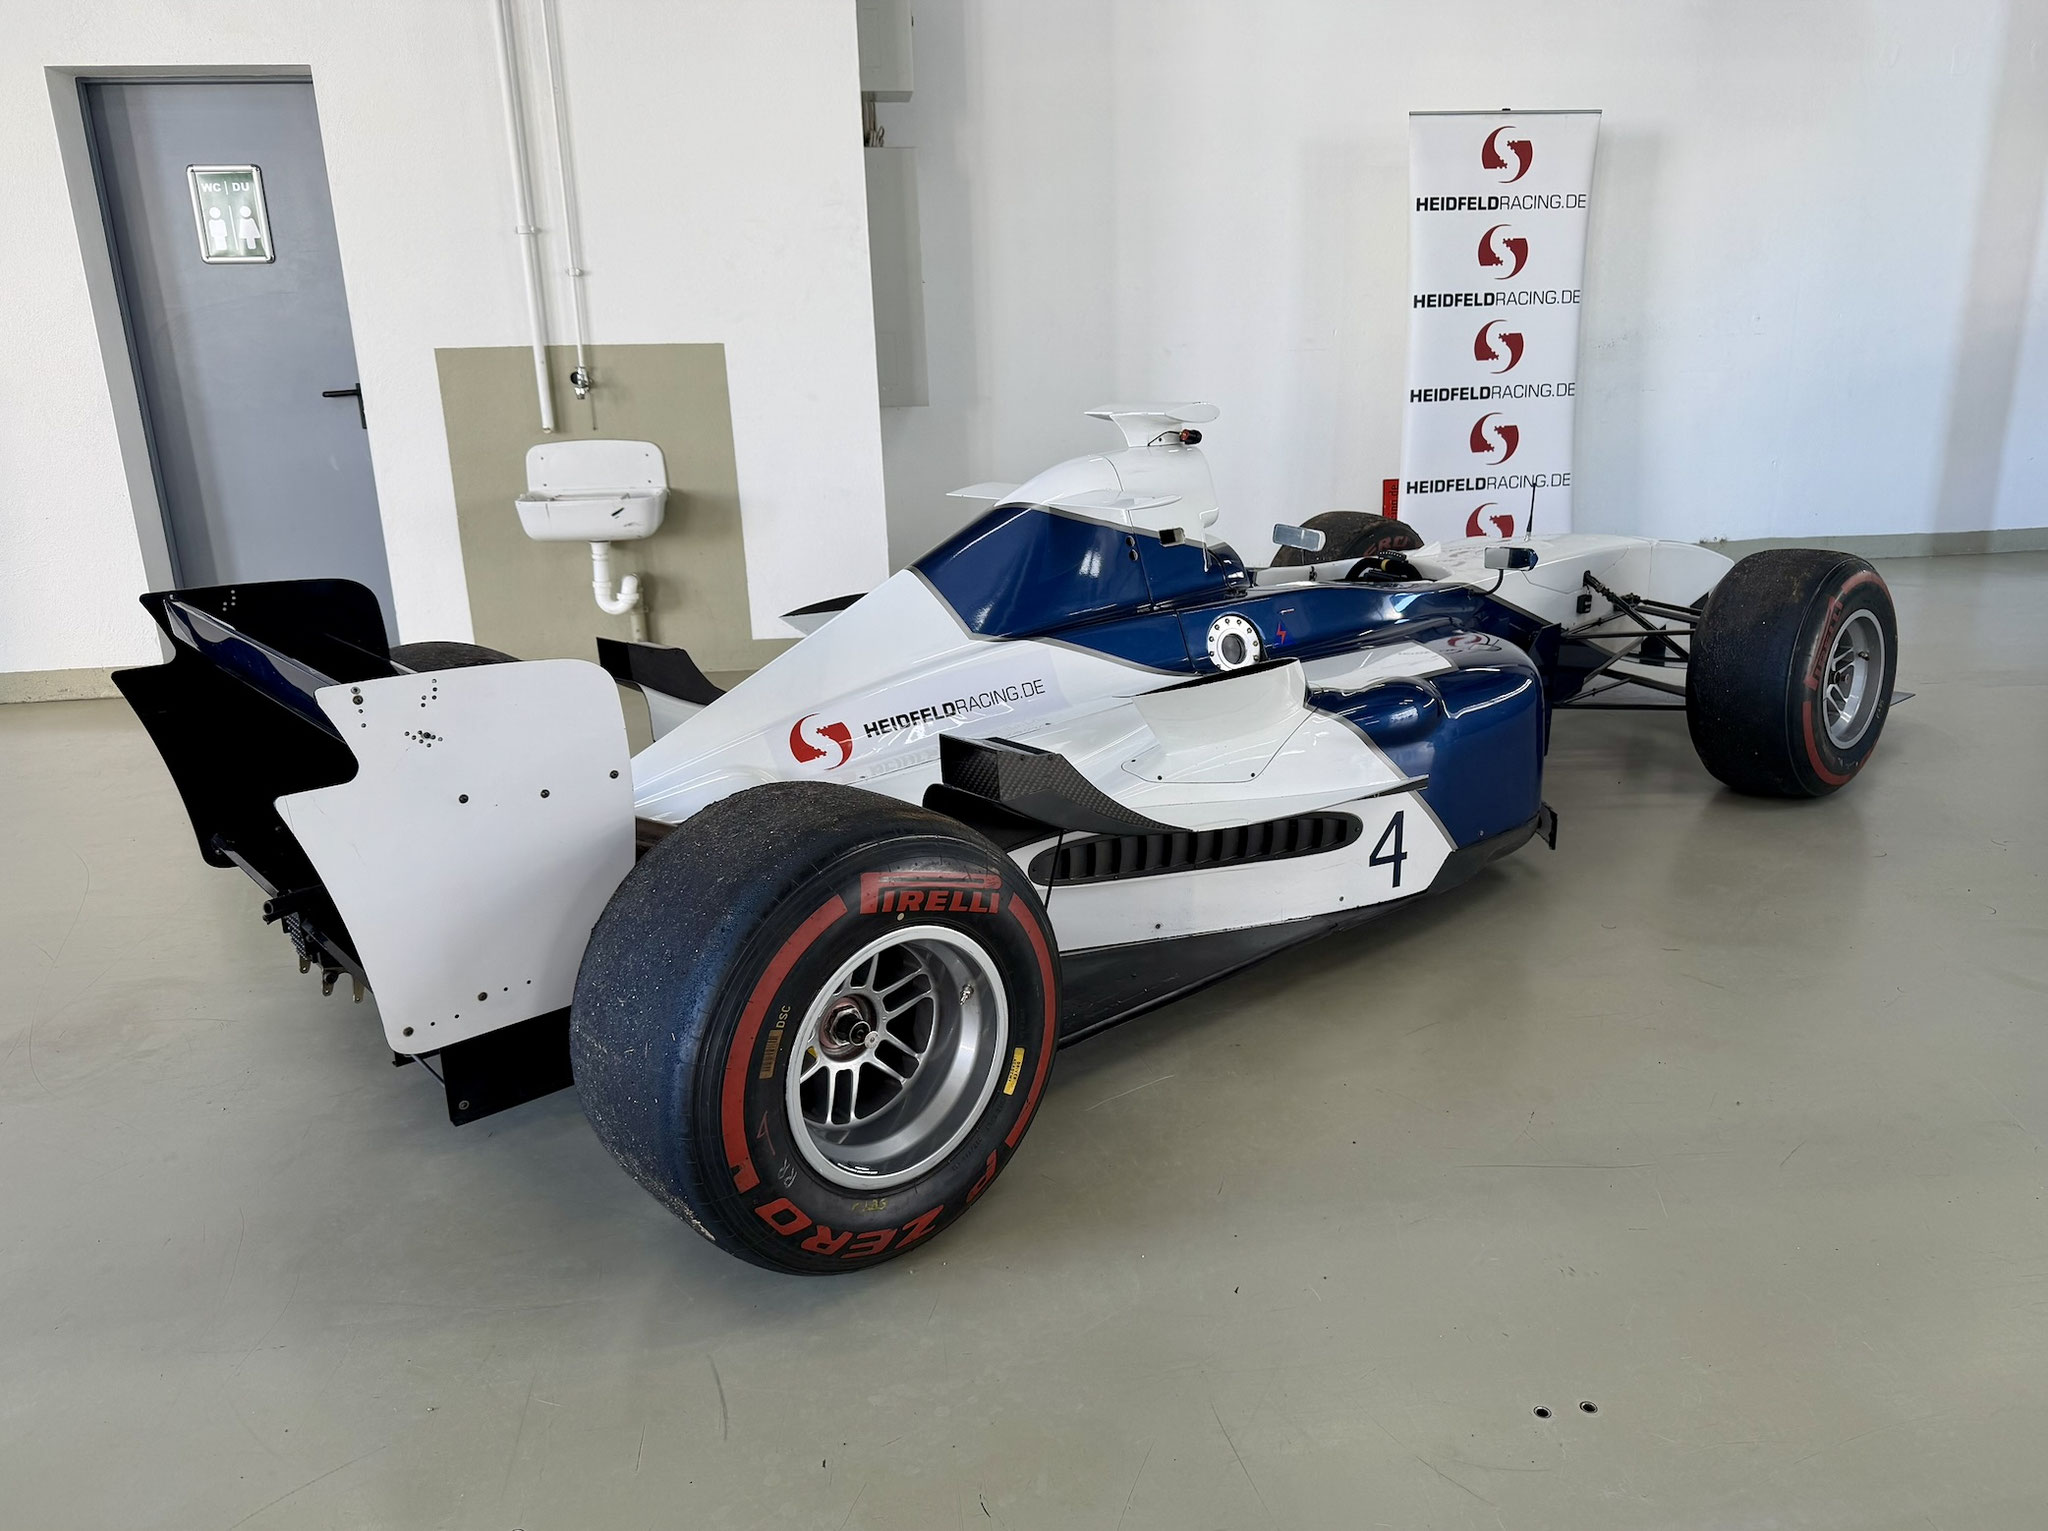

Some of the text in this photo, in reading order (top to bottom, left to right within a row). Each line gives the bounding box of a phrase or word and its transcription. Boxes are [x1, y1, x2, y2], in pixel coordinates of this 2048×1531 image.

[201, 182, 250, 192] WC DU
[1415, 194, 1587, 212] HEIDFELDRACING.DE
[1413, 289, 1581, 309] HEIDFELDRACING.DE
[1409, 382, 1576, 403] HEIDFELDRACING.DE
[1406, 473, 1571, 495] HEIDFELDRACING.DE
[863, 679, 1046, 738] HEIDFELDRACING.DE
[1369, 810, 1408, 888] 4
[860, 871, 1002, 915] PIRELLI
[775, 1005, 791, 1031] DSC
[754, 1197, 945, 1259] ZERO
